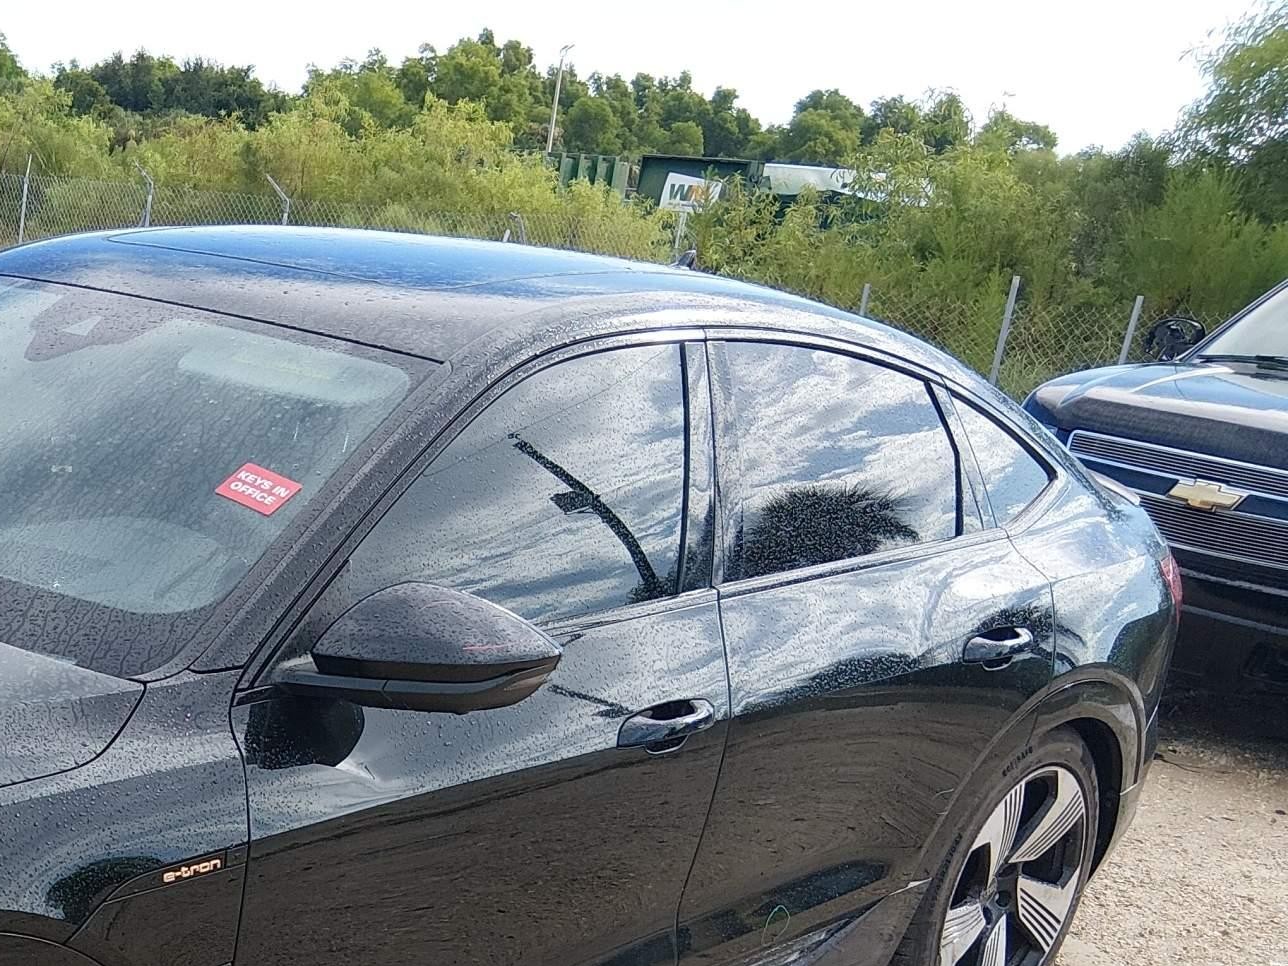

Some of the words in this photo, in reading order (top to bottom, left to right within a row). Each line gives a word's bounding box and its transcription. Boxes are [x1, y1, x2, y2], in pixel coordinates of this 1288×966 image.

[230, 481, 276, 505] OFFICE
[237, 471, 273, 489] KEYS
[272, 486, 290, 498] IN
[163, 859, 221, 882] e-tron
